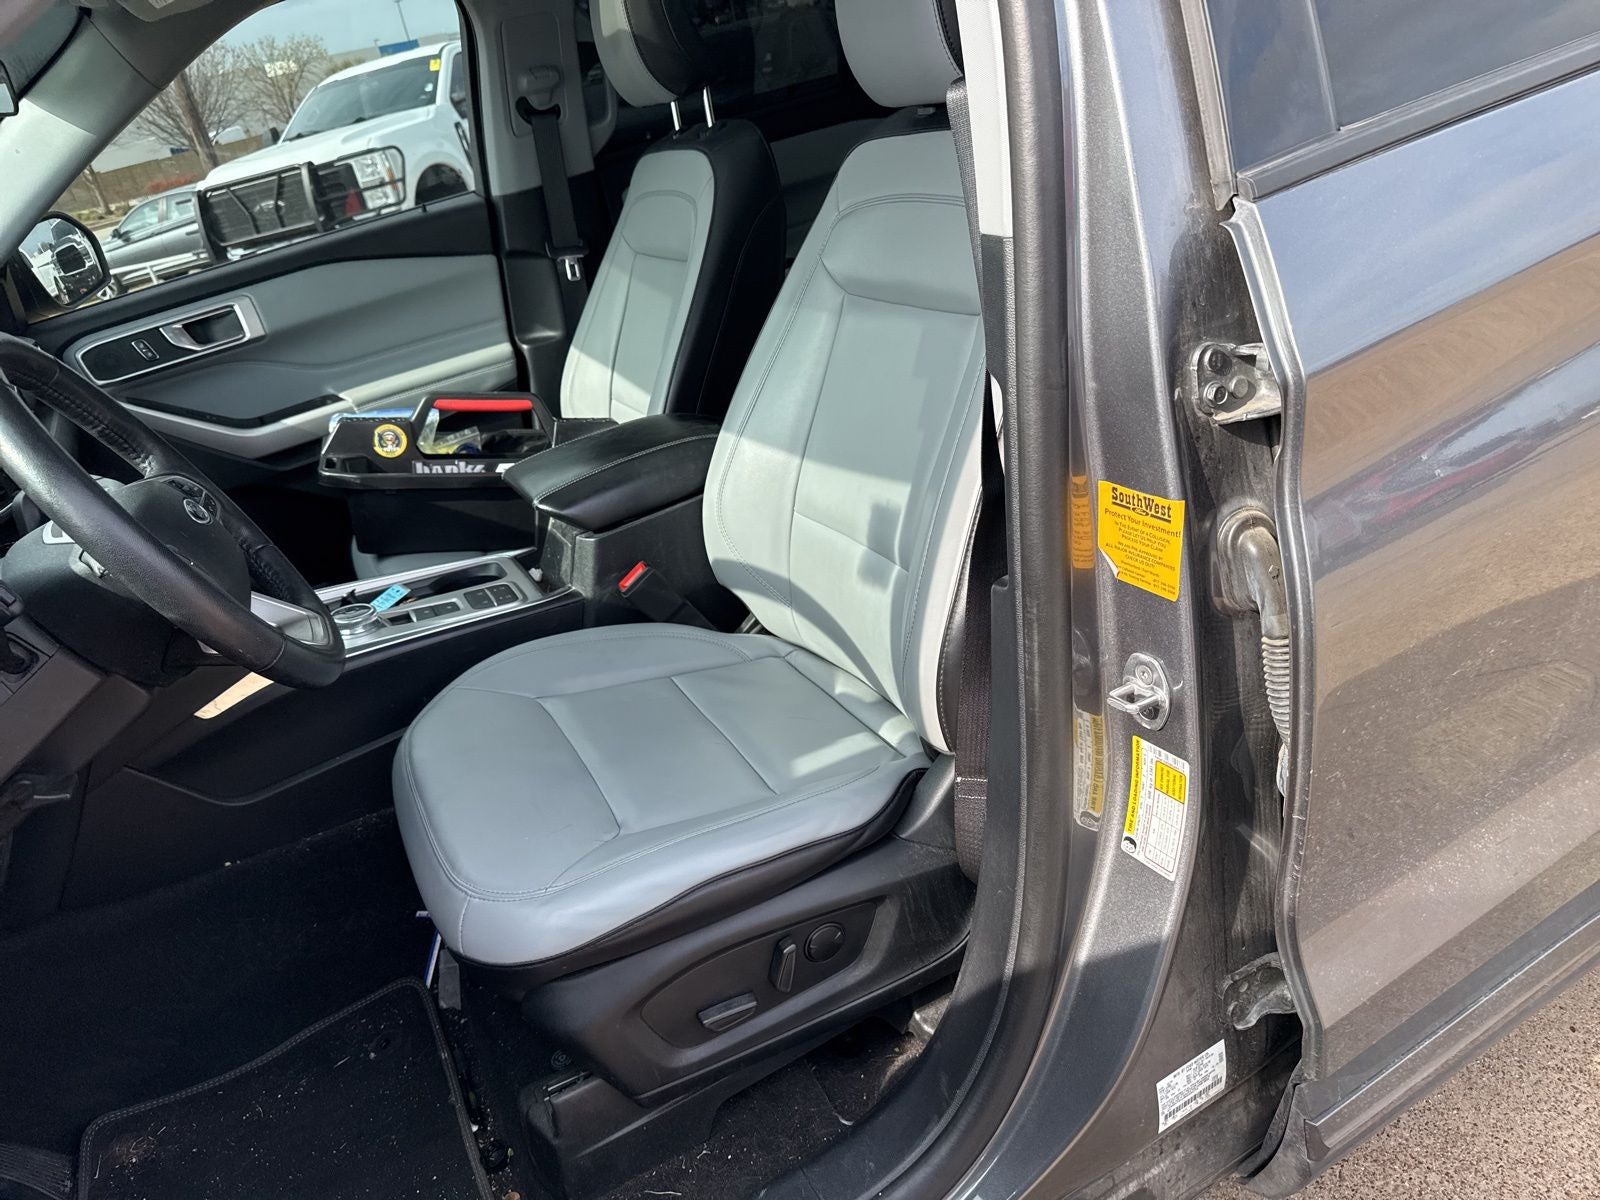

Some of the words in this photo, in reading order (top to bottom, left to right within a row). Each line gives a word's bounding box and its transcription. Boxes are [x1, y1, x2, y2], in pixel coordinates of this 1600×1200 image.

[1111, 486, 1172, 518] SouthWest
[1104, 507, 1126, 520] Protect
[1127, 515, 1140, 525] Your
[1142, 520, 1181, 538] Investment!
